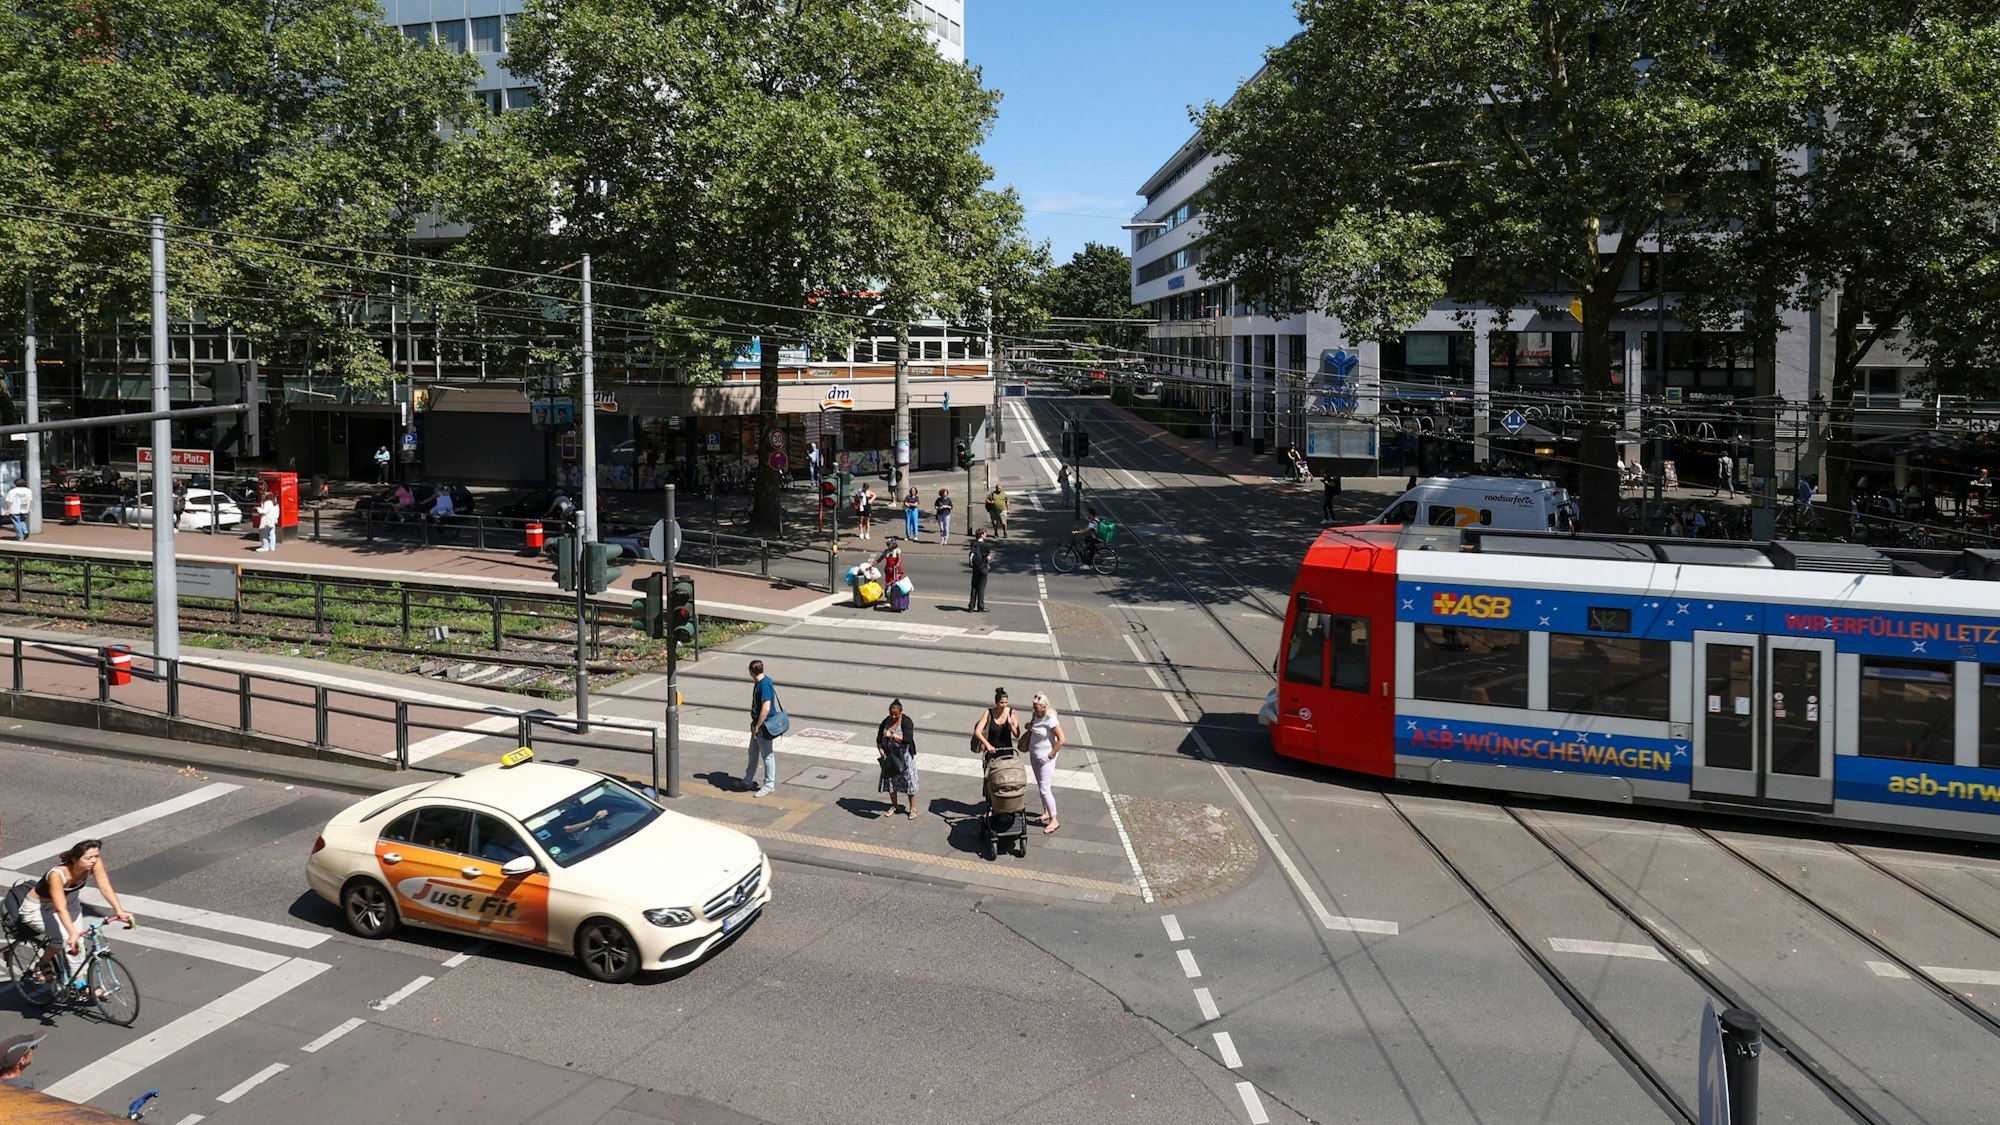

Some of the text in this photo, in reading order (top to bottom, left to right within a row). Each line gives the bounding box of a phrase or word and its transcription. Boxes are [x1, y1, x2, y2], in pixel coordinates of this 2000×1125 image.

[827, 386, 850, 400] dm
[773, 434, 781, 444] 30
[183, 453, 204, 463] Platz
[1452, 594, 1511, 619] ASB
[1785, 613, 1827, 633] WIR
[1830, 616, 1940, 640] ERFÜLLEN
[1411, 728, 1672, 772] ASB-WÜNSCHEWAGEN
[1888, 772, 2000, 802] asb-nrw
[412, 877, 519, 918] Just Fit
